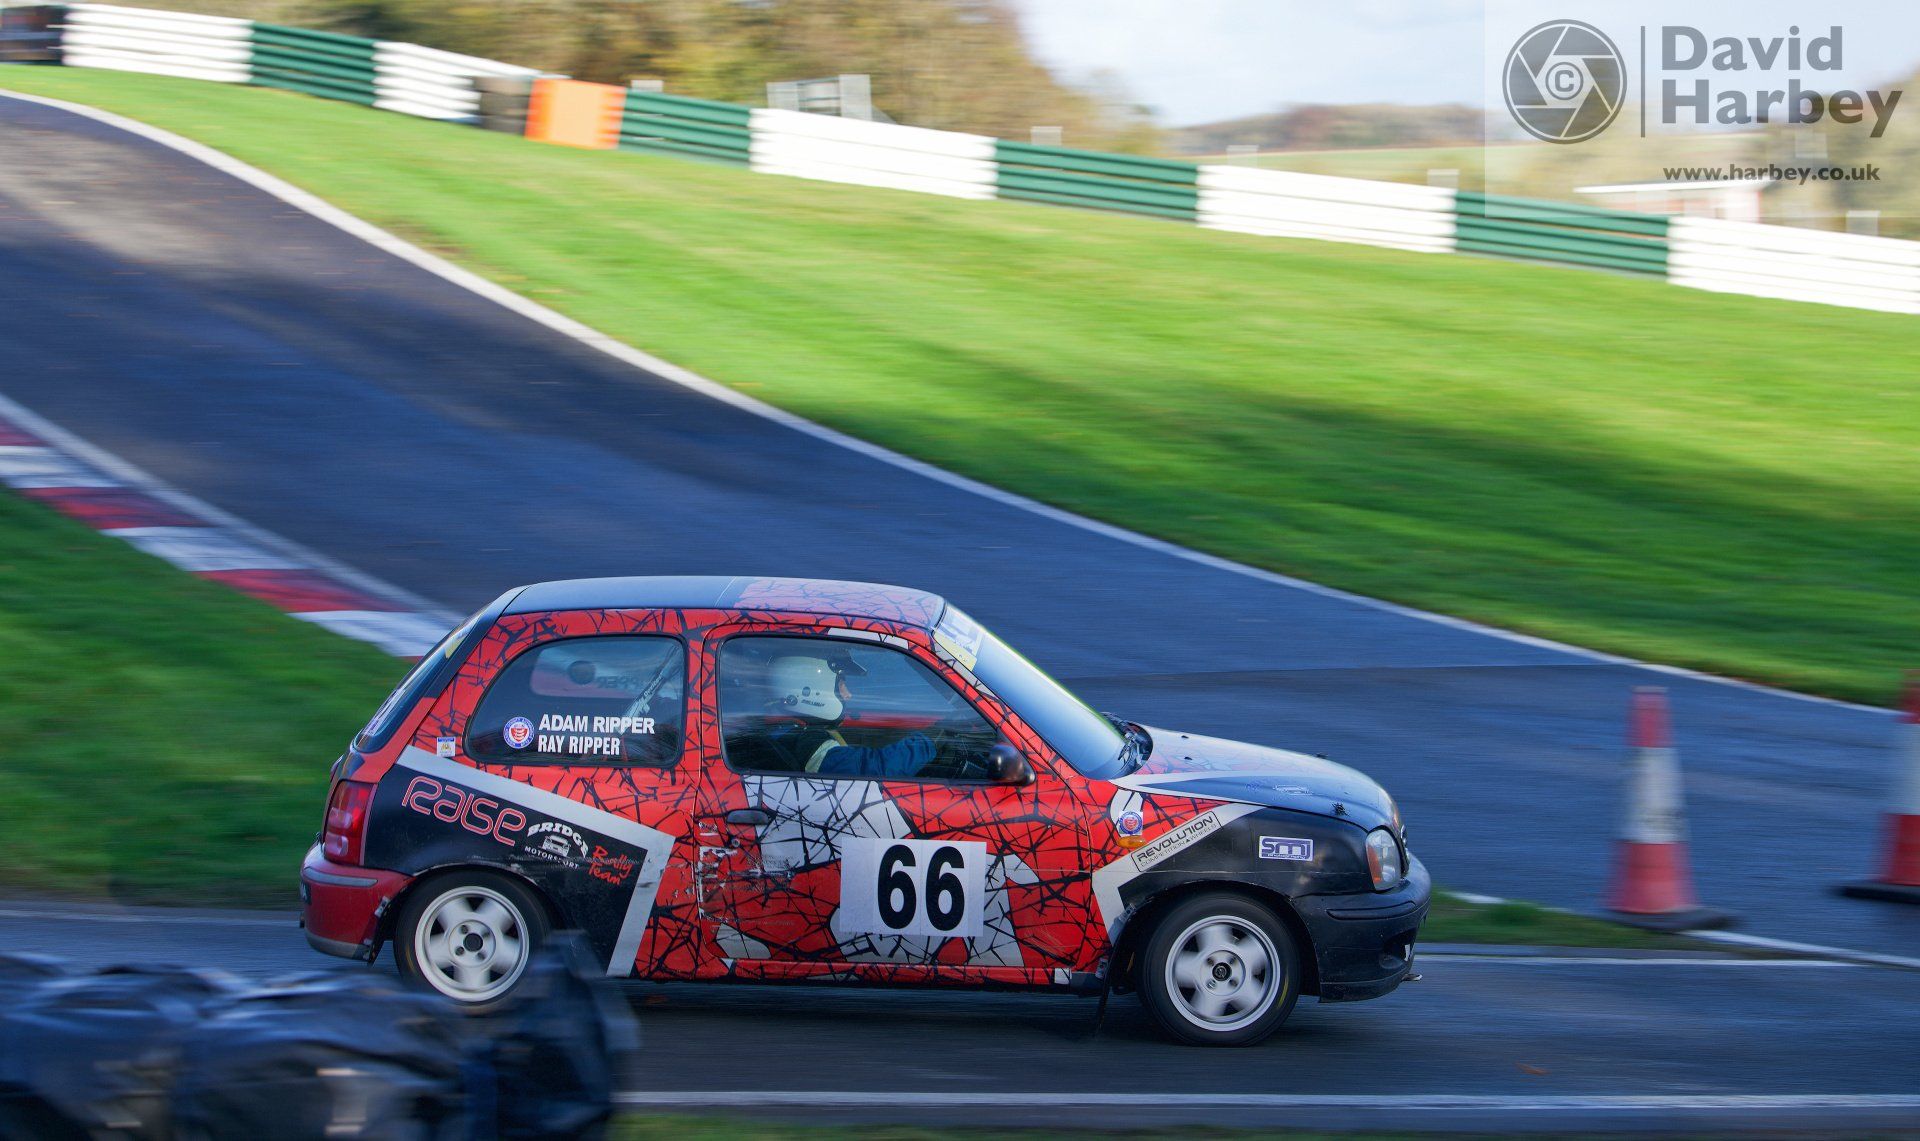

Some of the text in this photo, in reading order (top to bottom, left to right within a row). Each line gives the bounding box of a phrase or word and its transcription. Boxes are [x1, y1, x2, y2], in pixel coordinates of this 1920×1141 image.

[538, 714, 588, 733] ADAM
[592, 716, 656, 734] RIPPER
[537, 734, 621, 755] RAY RIPPER
[527, 821, 589, 858] BRIDGE
[1136, 815, 1214, 863] REVOLUTION
[588, 862, 621, 886] Team
[877, 844, 966, 932] 66
